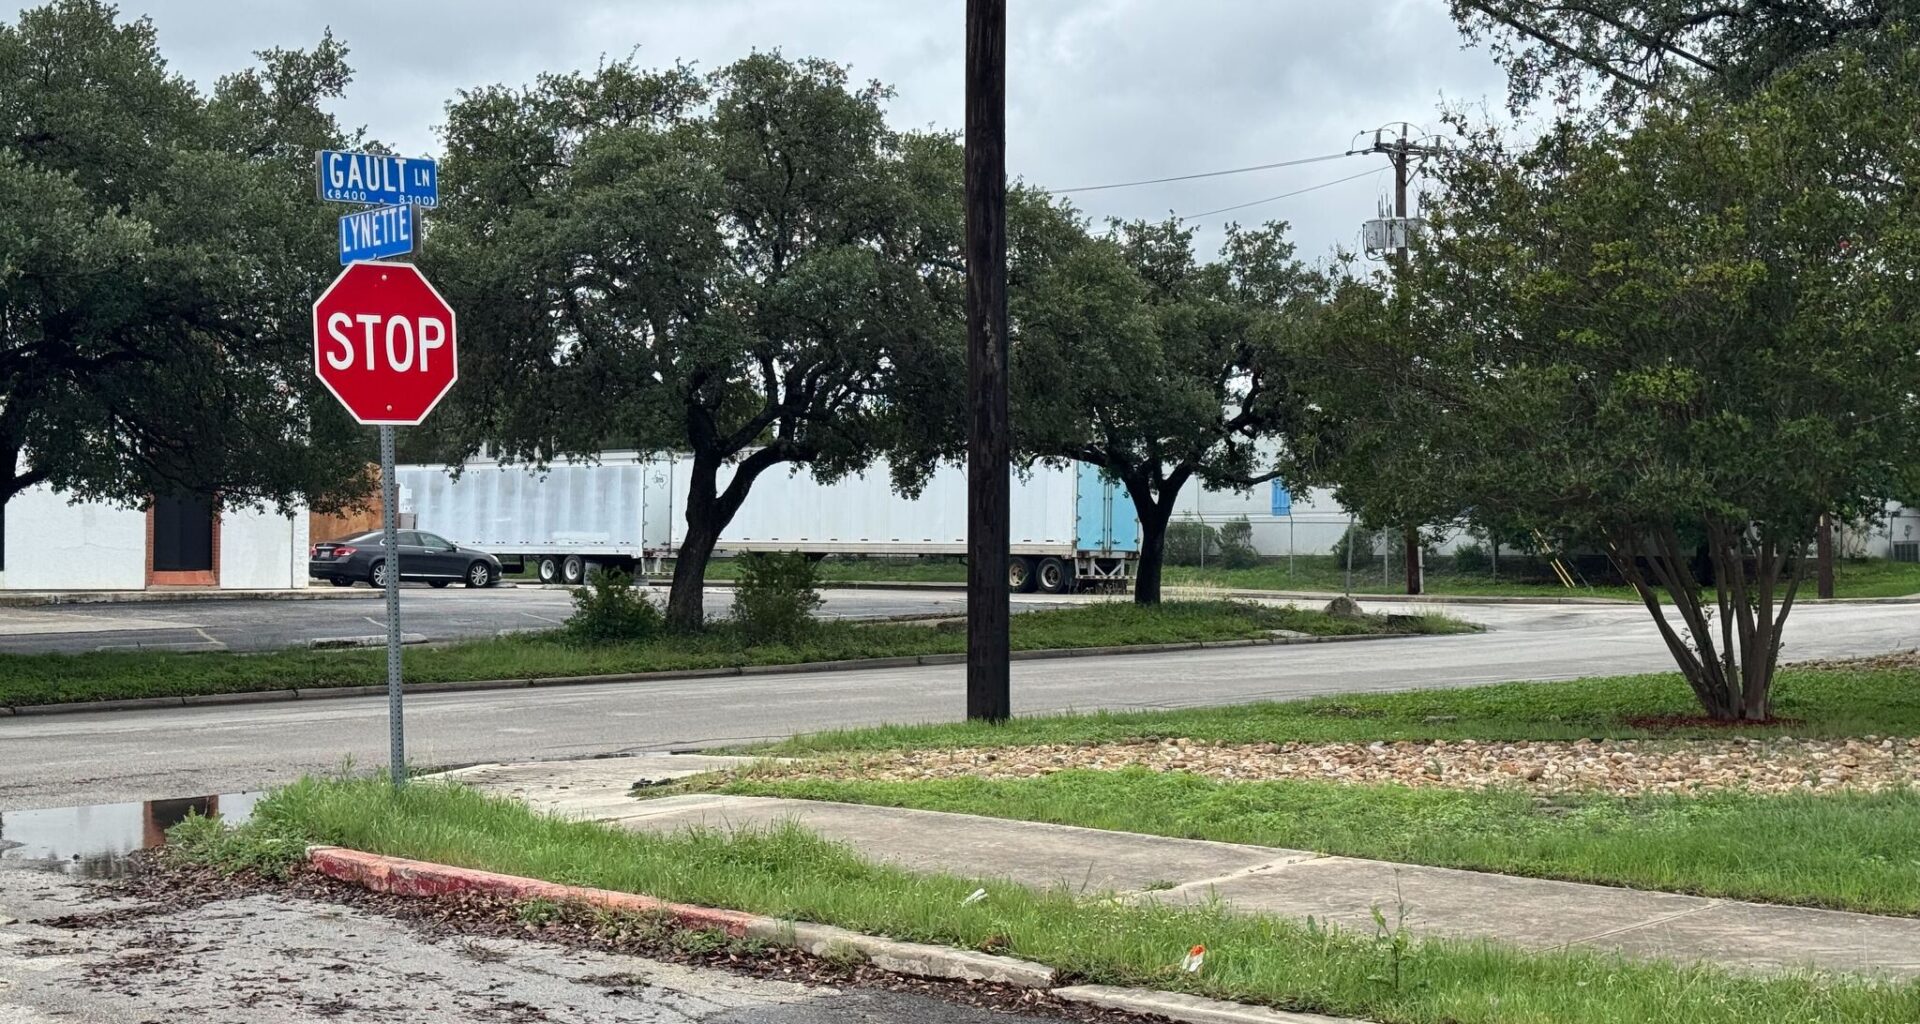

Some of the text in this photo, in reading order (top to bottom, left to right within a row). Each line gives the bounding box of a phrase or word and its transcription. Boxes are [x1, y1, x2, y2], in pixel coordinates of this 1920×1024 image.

[329, 153, 430, 193] GAULT LN
[335, 191, 430, 205] 8400 8300
[342, 206, 408, 253] LYNETTE
[326, 312, 446, 373] STOP
